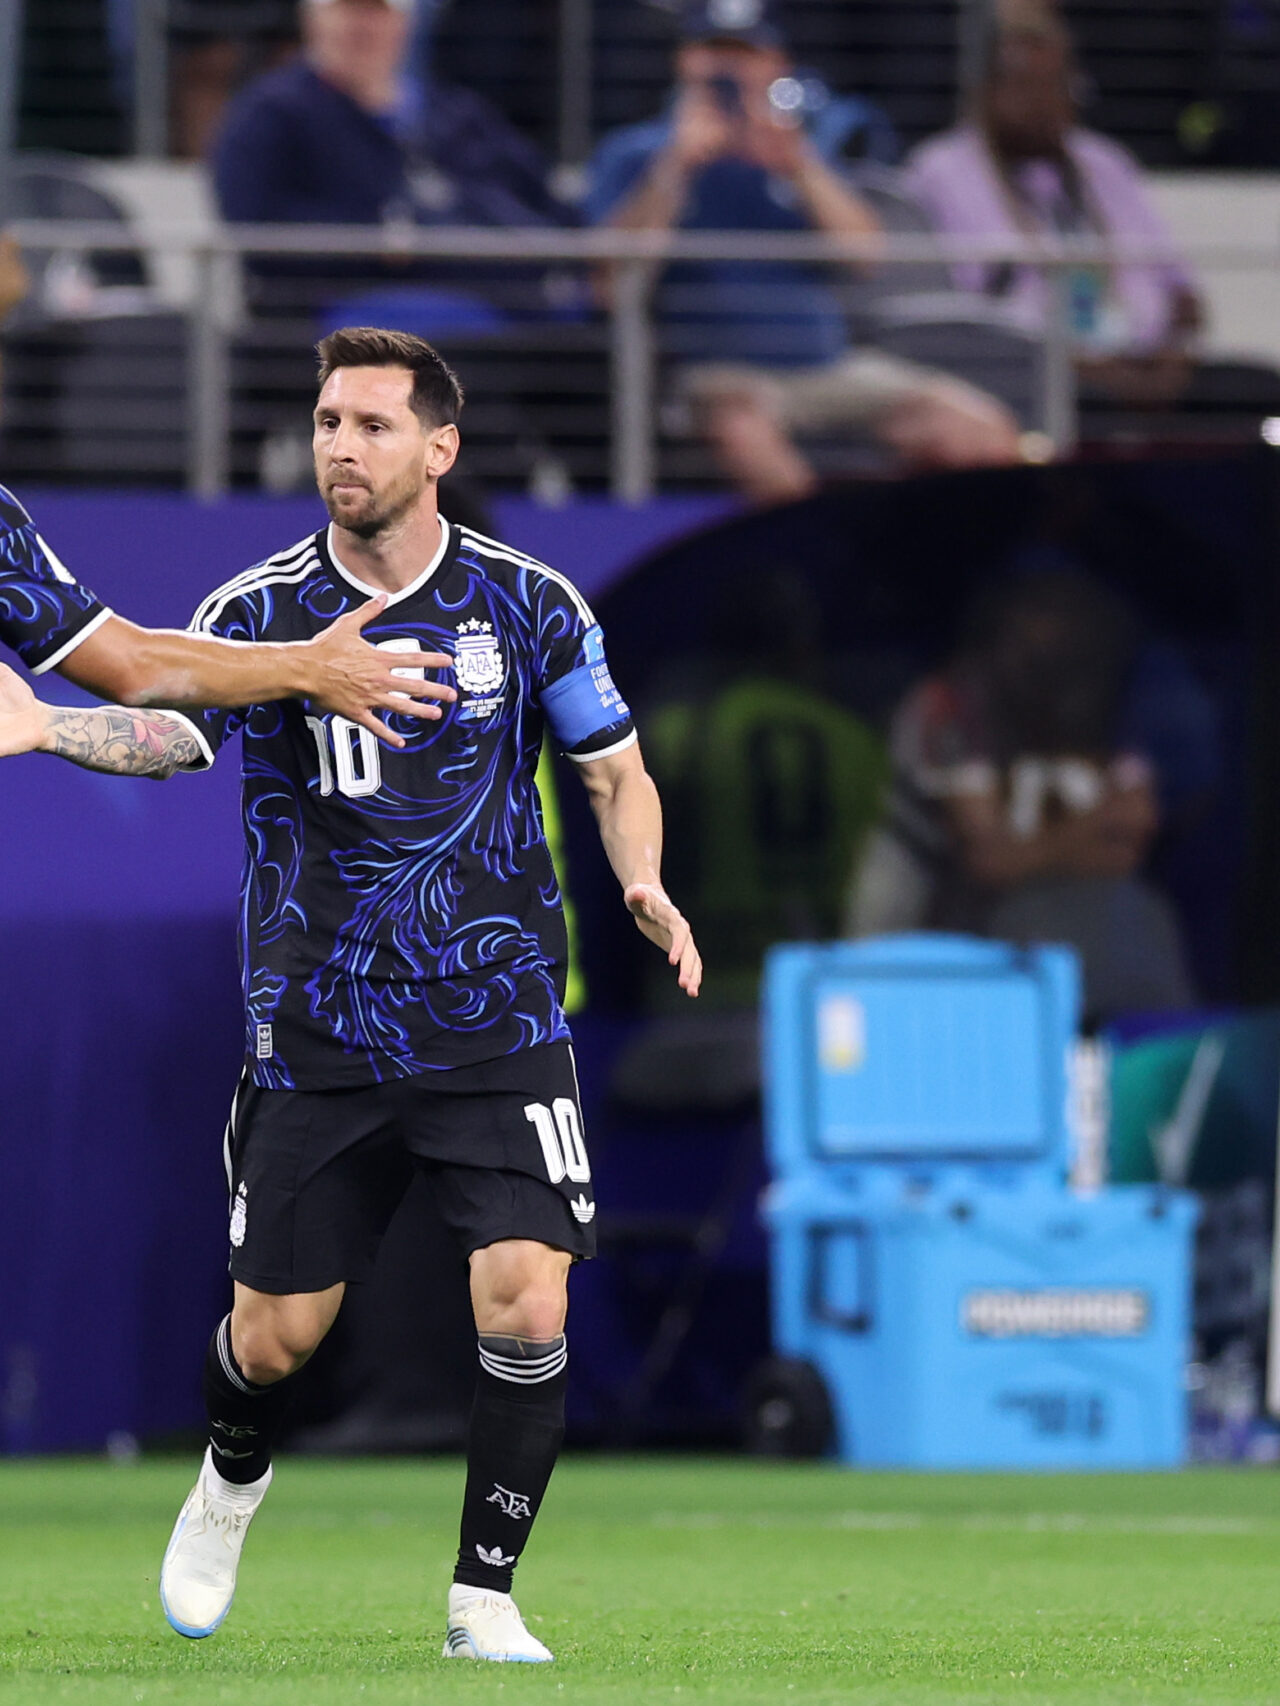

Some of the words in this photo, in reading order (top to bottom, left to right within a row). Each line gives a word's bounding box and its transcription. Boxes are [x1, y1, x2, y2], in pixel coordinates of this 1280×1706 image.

[466, 649, 493, 676] AFA
[304, 714, 382, 798] 10
[523, 1097, 591, 1184] 10
[485, 1482, 532, 1519] AFA
